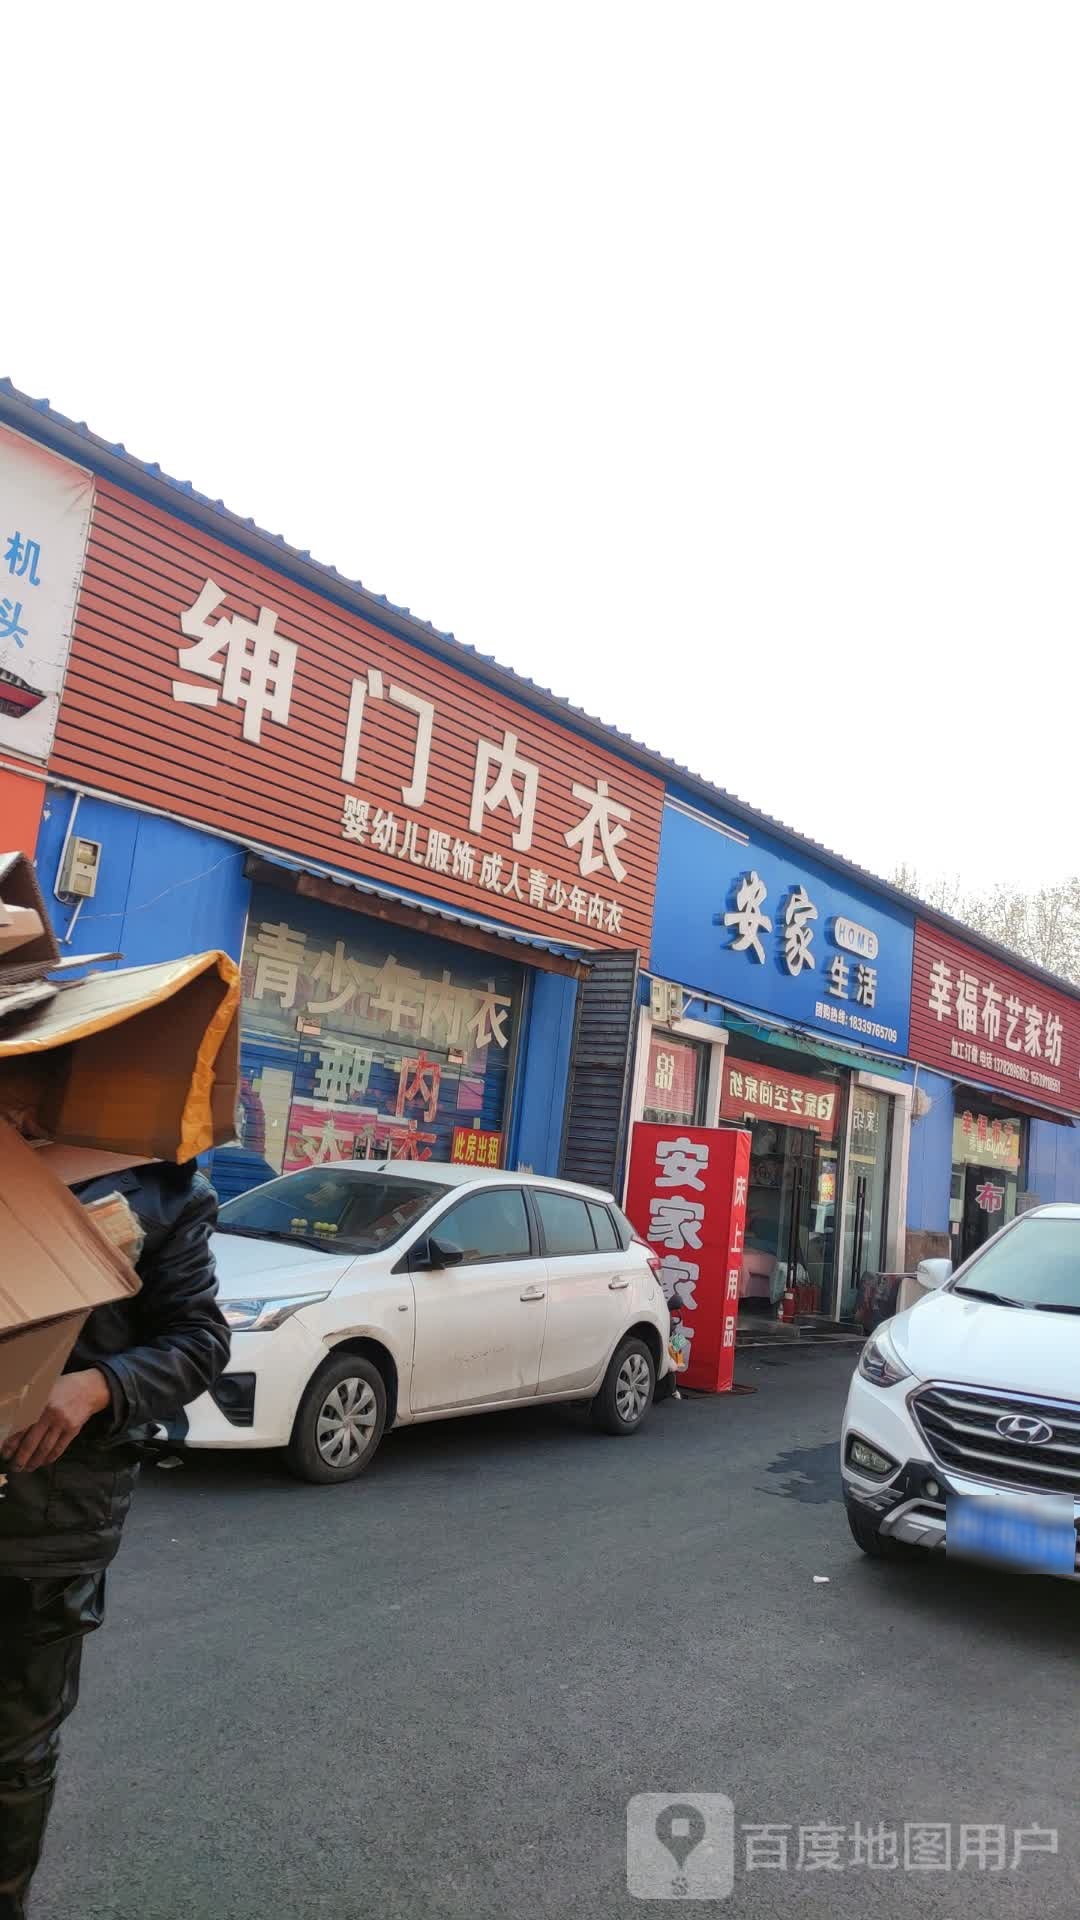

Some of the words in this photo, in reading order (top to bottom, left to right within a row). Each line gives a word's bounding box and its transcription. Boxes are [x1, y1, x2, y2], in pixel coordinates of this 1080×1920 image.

[4, 531, 41, 586] 机
[171, 578, 632, 883] 绅门内衣
[341, 794, 476, 881] 婴幼儿服饰
[478, 851, 624, 934] 成人青少年内衣
[724, 871, 819, 976] 安家
[838, 920, 874, 954] HOME
[829, 955, 877, 1008] 生活
[928, 960, 1063, 1066] 幸福布艺家纺
[454, 1132, 499, 1163] 此房出租
[975, 1181, 1005, 1213] 布
[723, 1175, 747, 1347] 床上用品
